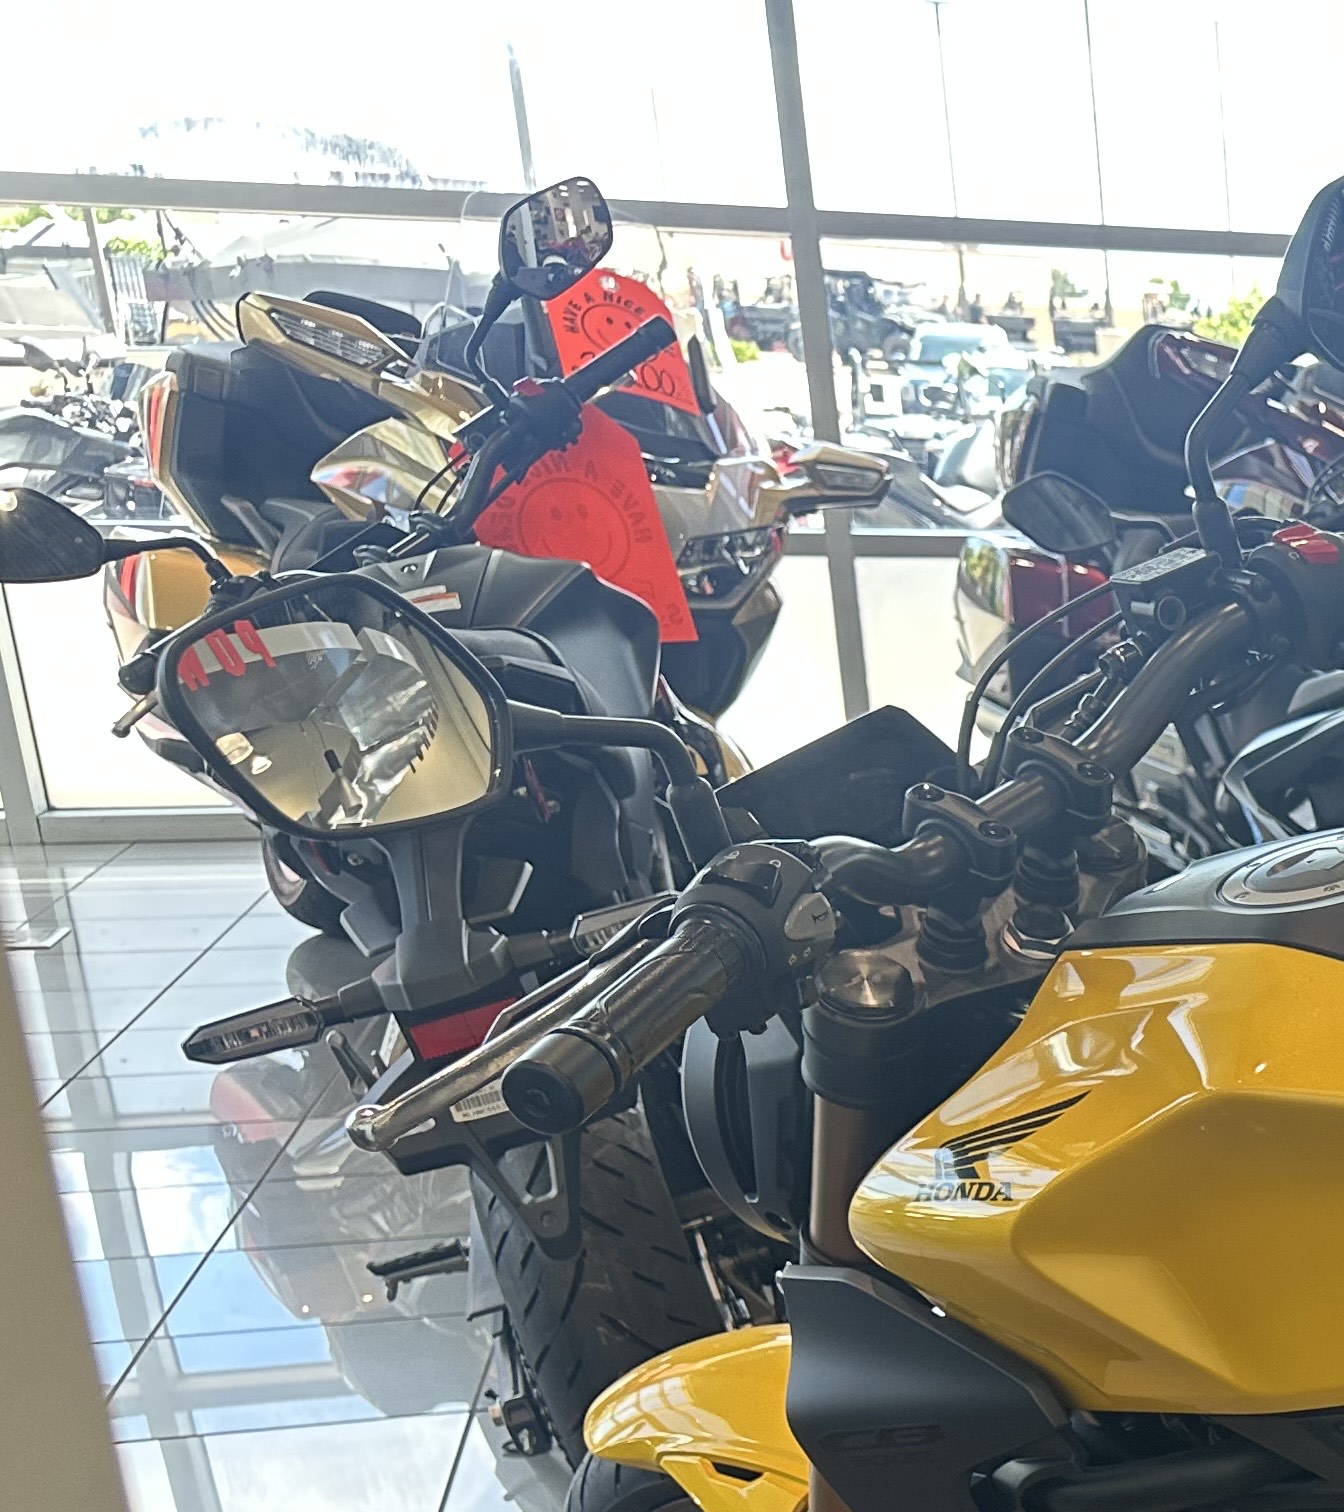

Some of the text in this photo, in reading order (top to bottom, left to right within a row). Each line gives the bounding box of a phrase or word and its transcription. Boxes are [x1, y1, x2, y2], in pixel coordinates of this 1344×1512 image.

[562, 300, 582, 334] HAVE
[603, 290, 646, 316] NICE
[913, 1182, 1014, 1202] HONDA
